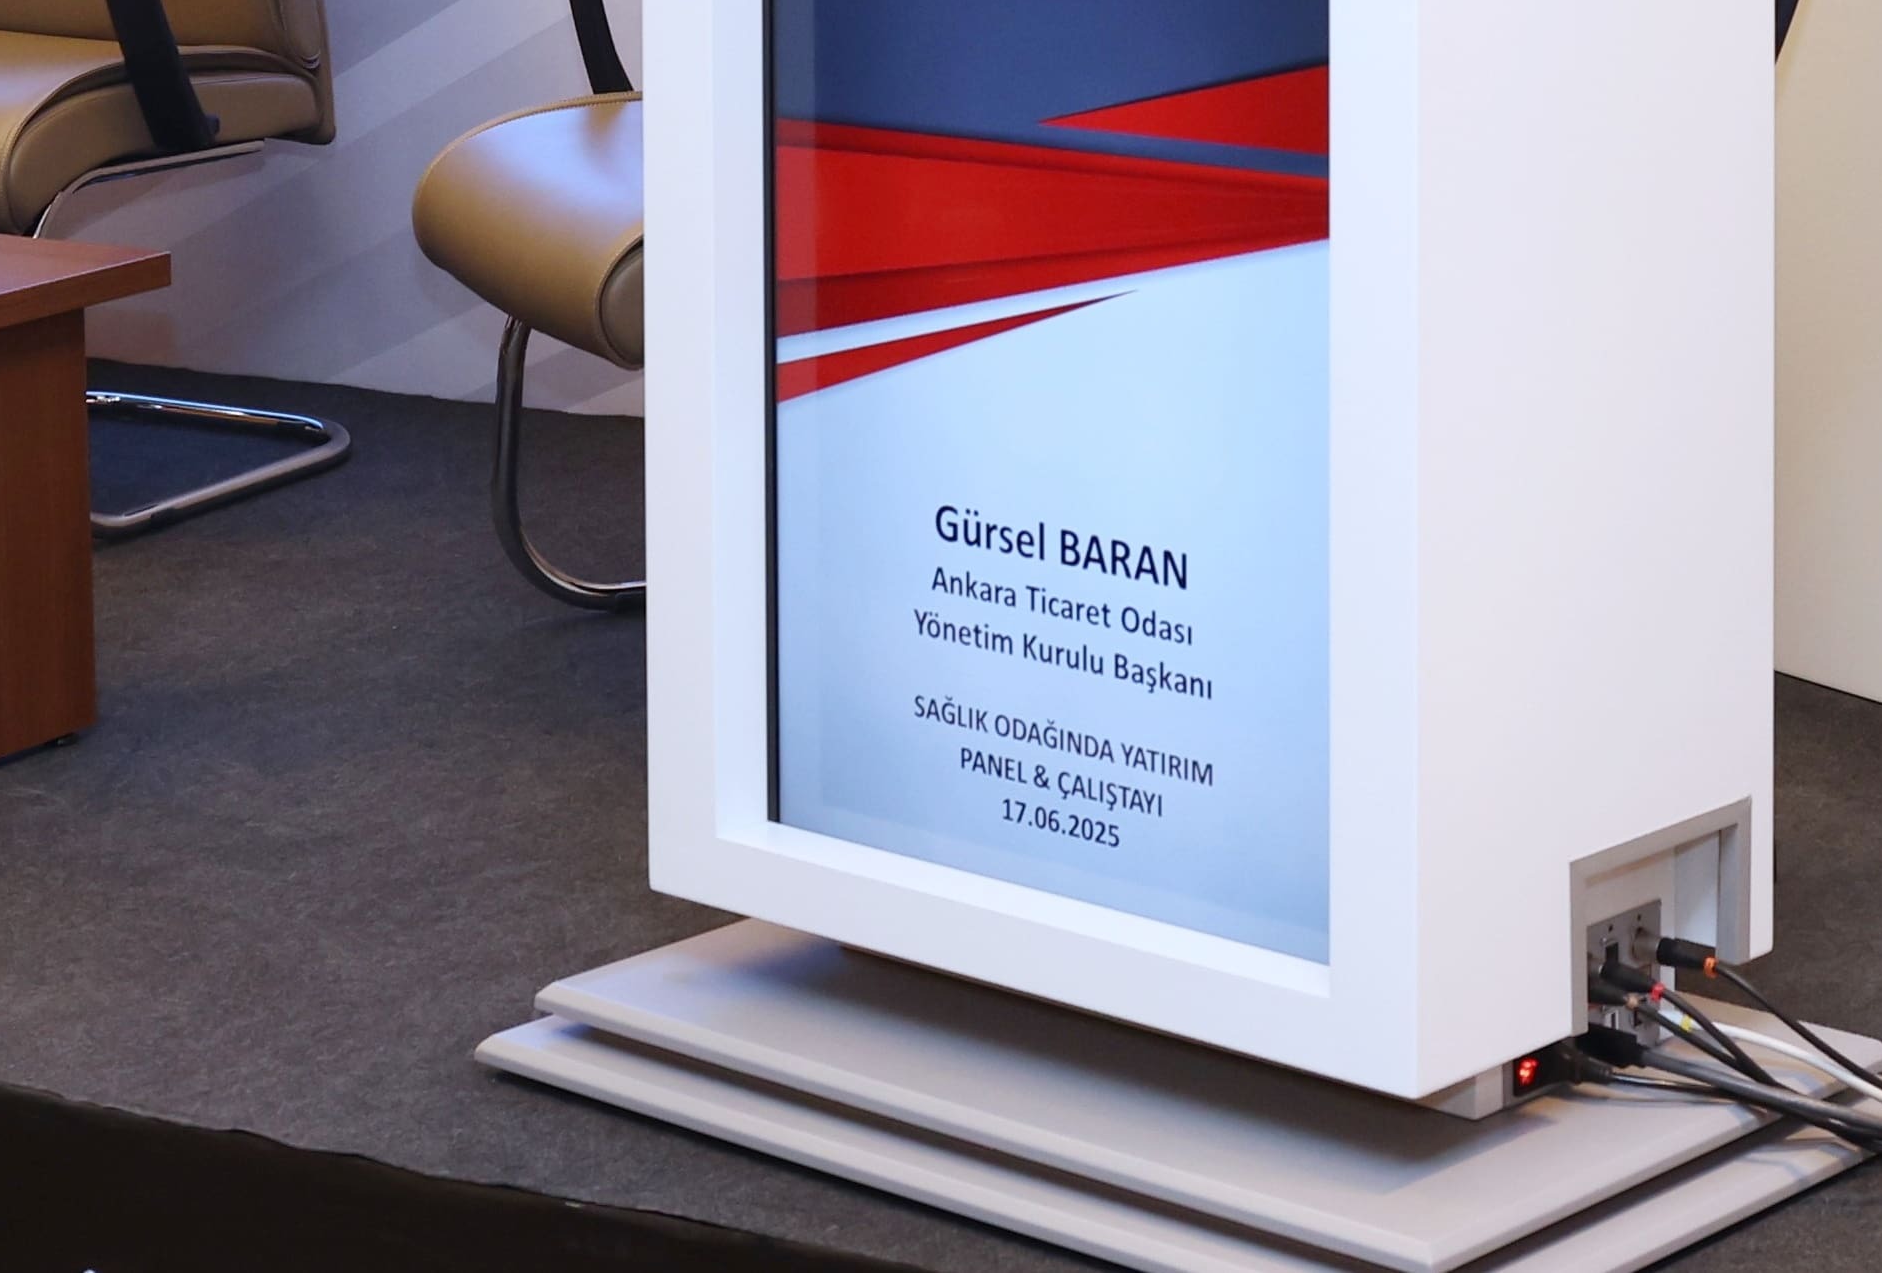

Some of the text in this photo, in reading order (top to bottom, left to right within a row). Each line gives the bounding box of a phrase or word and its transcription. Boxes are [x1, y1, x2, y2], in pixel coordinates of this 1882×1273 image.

[936, 506, 1186, 589] Gürsel BARAN
[932, 567, 1191, 645] Ankara Ticaret Odası
[914, 609, 1211, 699] Yönetim Kurulu Başkanı
[915, 695, 1212, 786] SAĞLIK ODAĞINDA YATIRIM
[961, 748, 1162, 817] PANEL & ÇALIŞTAYI
[1003, 799, 1119, 847] 17.06.2025
